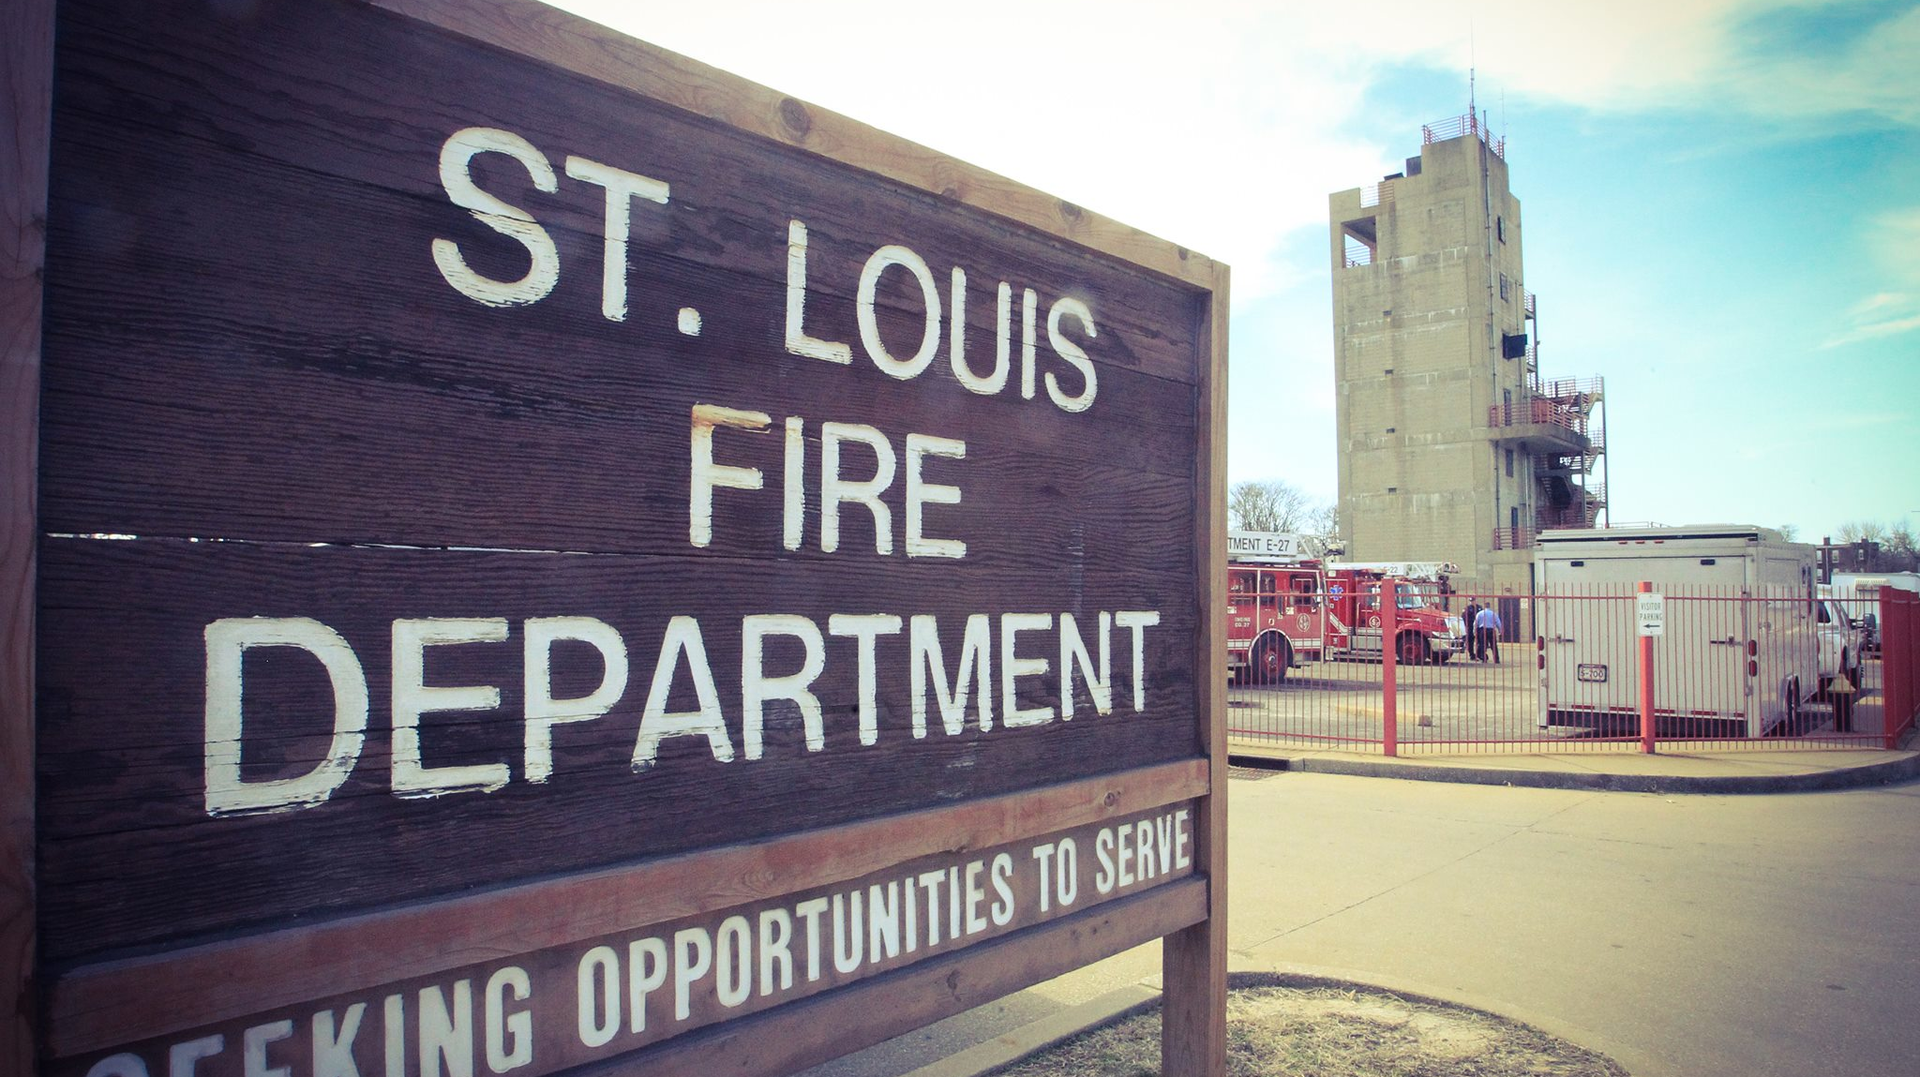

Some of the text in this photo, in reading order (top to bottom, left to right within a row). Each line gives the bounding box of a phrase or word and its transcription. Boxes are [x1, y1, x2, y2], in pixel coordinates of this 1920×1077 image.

[431, 126, 1098, 413] ST. LOUIS
[688, 403, 967, 560] FIRE
[1266, 539, 1290, 552] E-27
[1639, 612, 1663, 621] PARKING
[1640, 602, 1661, 611] VISITOR
[203, 610, 1161, 818] DEPARTMENT
[86, 809, 1191, 1077] EKING OPPORTUNITIES TO SERVE
